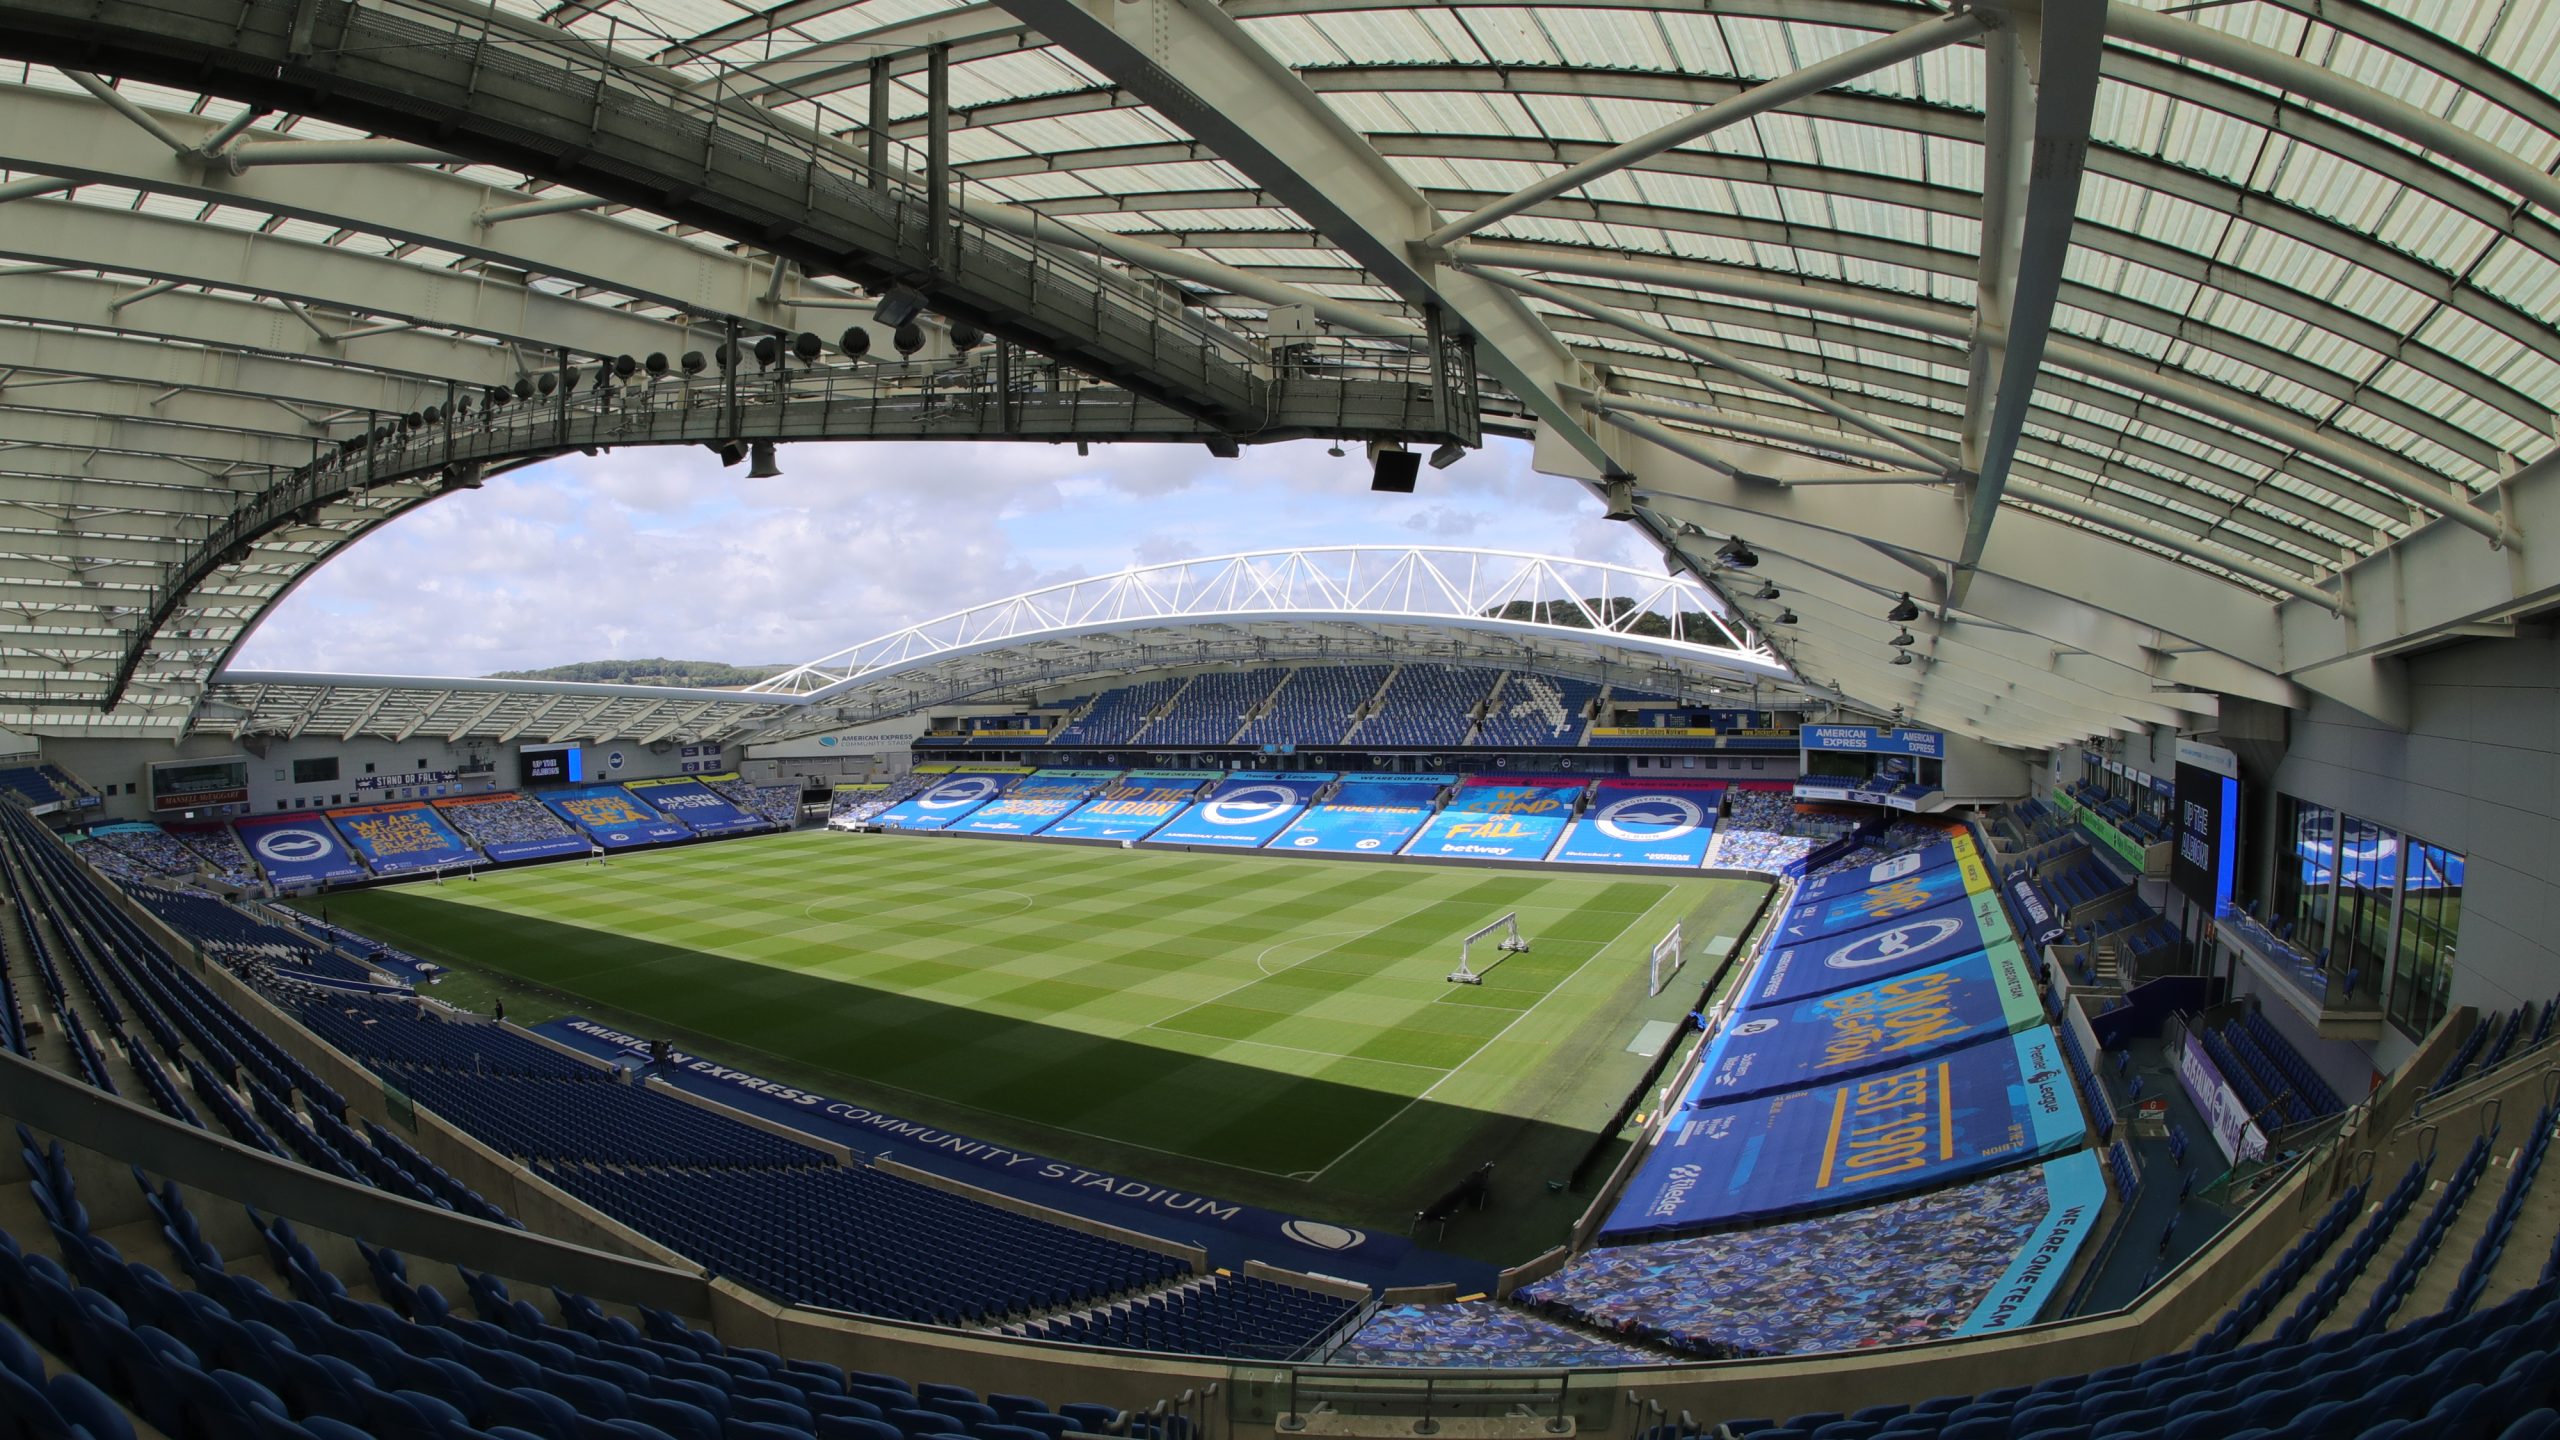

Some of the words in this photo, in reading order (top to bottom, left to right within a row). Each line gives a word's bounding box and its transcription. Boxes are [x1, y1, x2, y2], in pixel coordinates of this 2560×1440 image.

[881, 733, 913, 741] EXPRESS
[1815, 728, 1867, 739] AMERICAN
[1903, 732, 1935, 744] AMERICAN
[1823, 738, 1867, 748] EXPRESS
[1909, 743, 1935, 754] EXPRESS
[376, 775, 402, 786] STAND
[405, 774, 415, 783] OR
[418, 772, 438, 782] FALL
[657, 793, 715, 805] ALBION
[1107, 787, 1145, 801] UP
[1143, 788, 1196, 803] THE
[1086, 801, 1177, 817] ALBION
[1469, 799, 1561, 815] STAND
[349, 819, 384, 832] WE
[388, 813, 421, 827] ARE
[580, 809, 651, 826] SEA
[2184, 800, 2194, 827] UP
[2193, 804, 2209, 836] THE
[1445, 822, 1538, 840] FALL
[1441, 844, 1514, 856] betway
[1880, 972, 1976, 1052] C'MON
[1815, 991, 1883, 1069] BRIGHTON
[2028, 1043, 2047, 1070] Premier
[2038, 1084, 2059, 1114] League
[1855, 1068, 1927, 1117] EST
[2150, 1101, 2157, 1110] G
[567, 1021, 694, 1065] AMERICN
[689, 1061, 826, 1106] EXPRESS
[826, 1103, 1034, 1168] COMMUNITY
[1038, 1163, 1241, 1222] STADIUM
[1842, 1112, 1927, 1184] 1901
[1654, 1176, 1697, 1217] fileder
[2055, 1204, 2086, 1228] WE
[2036, 1228, 2070, 1254] ARE
[2014, 1254, 2052, 1285] ONE
[1982, 1285, 2033, 1329] TEAM
